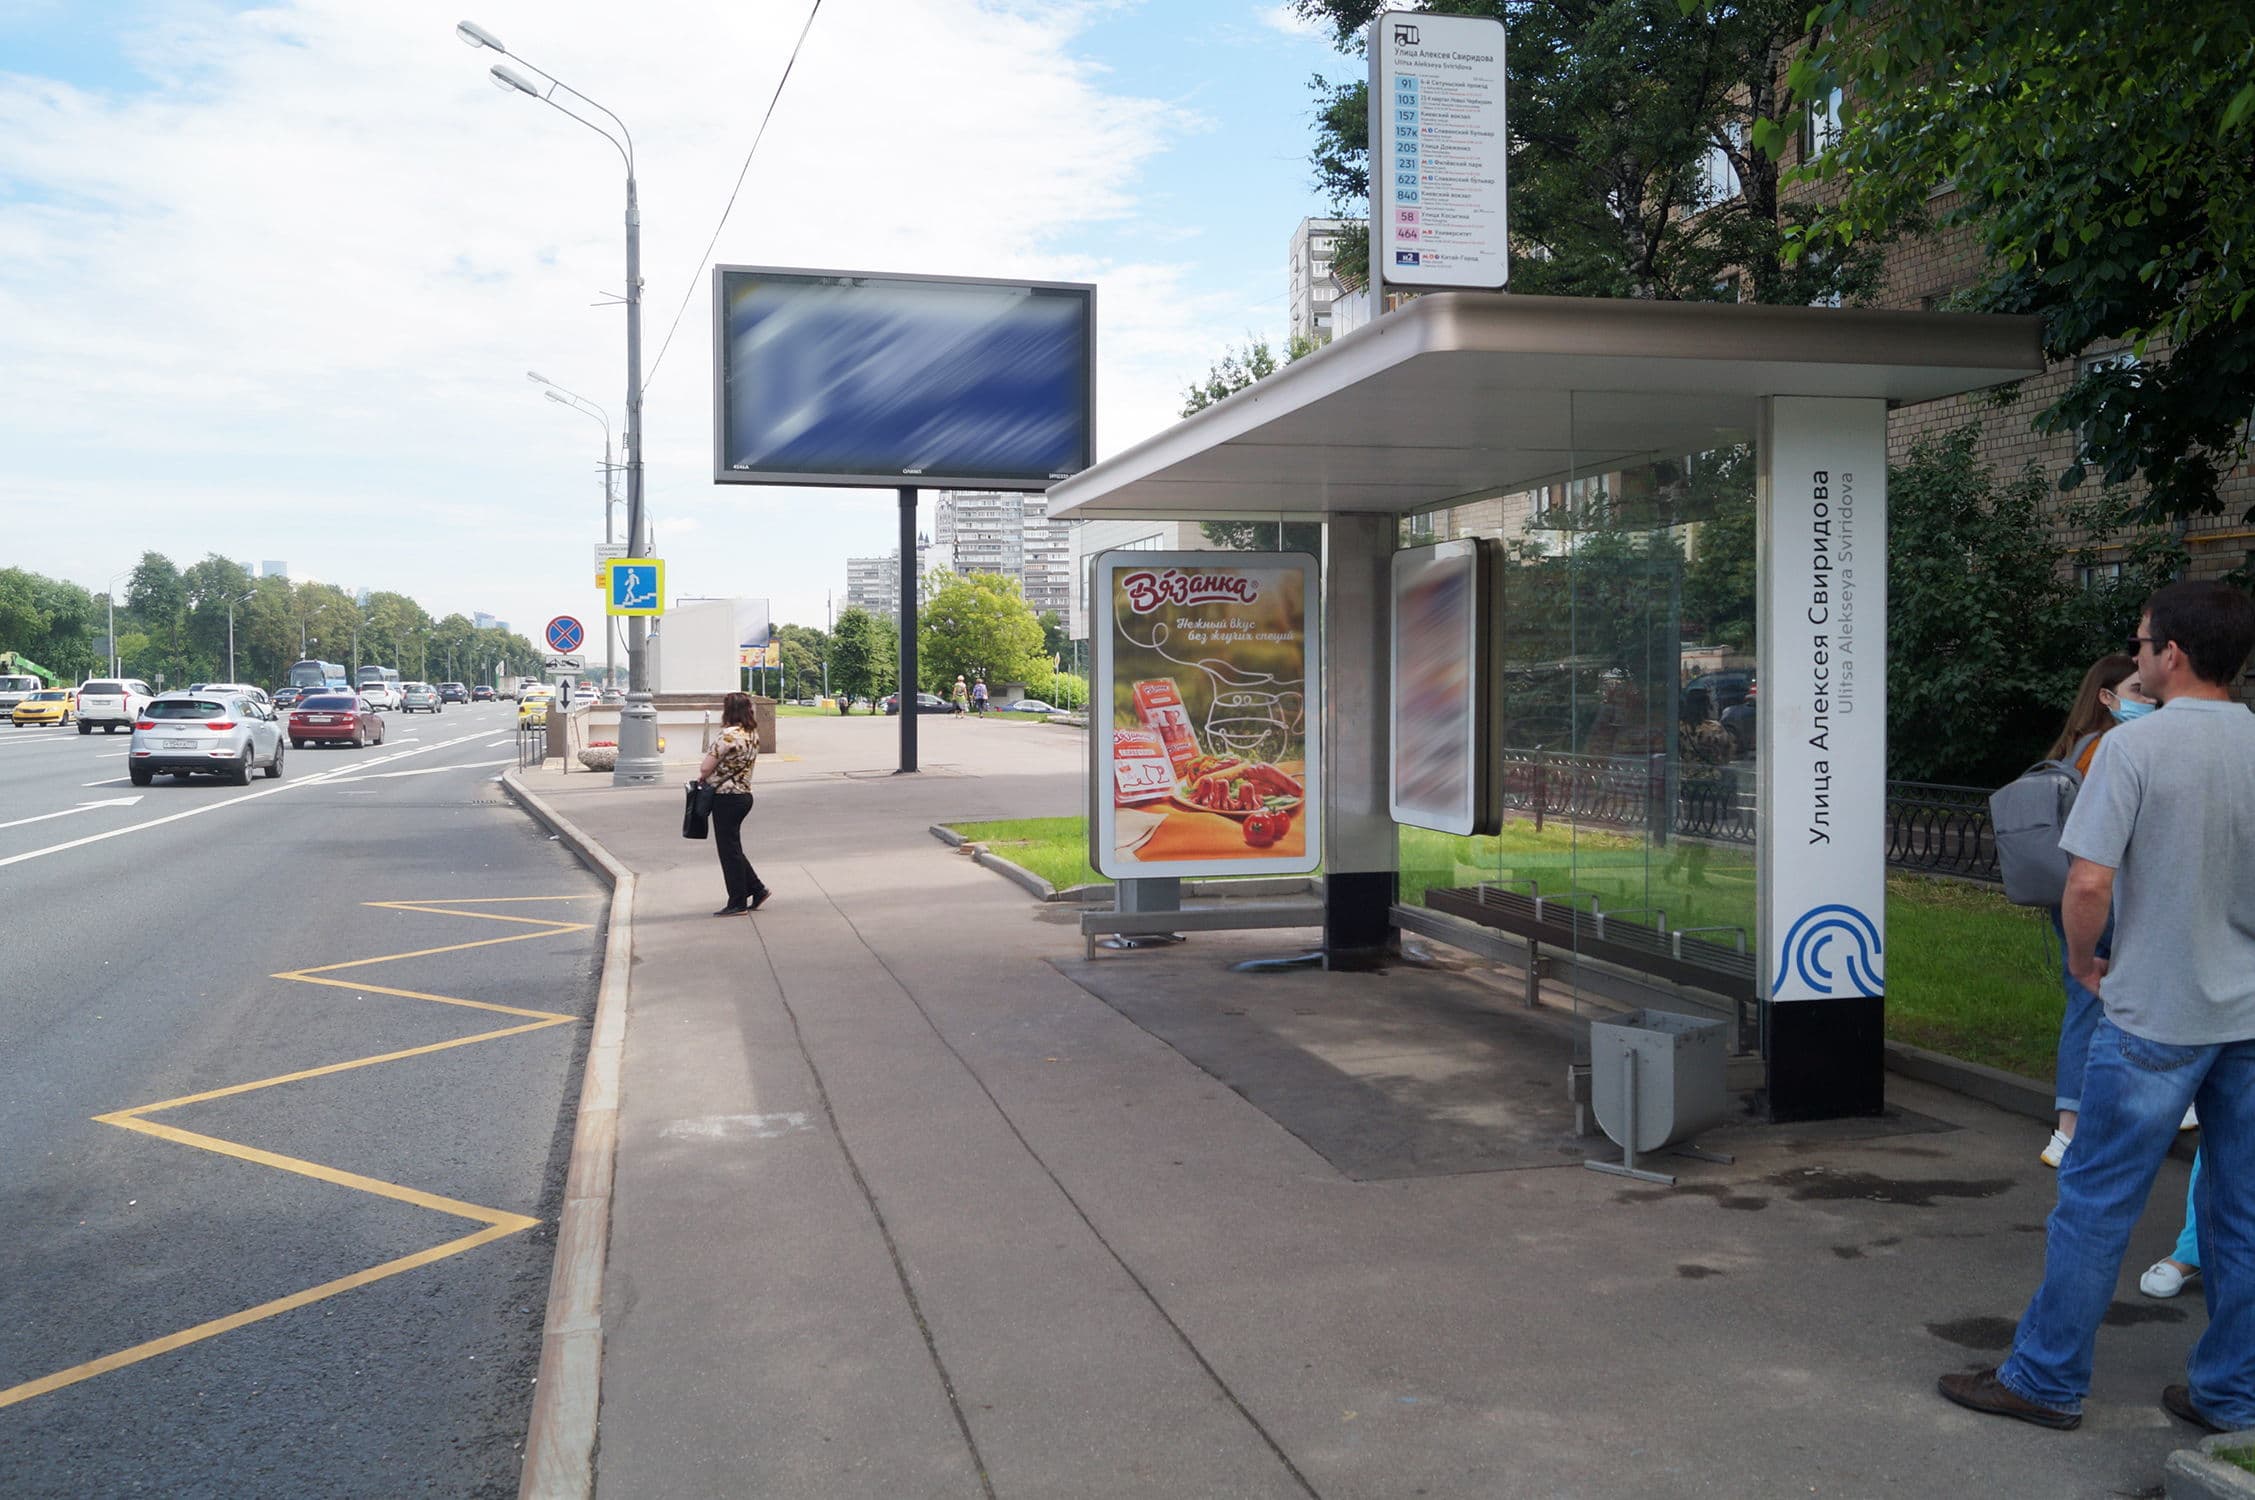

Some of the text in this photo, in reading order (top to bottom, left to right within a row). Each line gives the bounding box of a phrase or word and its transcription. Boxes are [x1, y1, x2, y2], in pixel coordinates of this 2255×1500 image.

[1394, 48, 1494, 62] Улица Алексея Свиридова
[1394, 58, 1472, 70] Ulitsa Alekseya Sviridova
[1401, 79, 1412, 88] 91
[1398, 94, 1416, 104] 103
[1400, 110, 1415, 120] 157
[1398, 142, 1417, 152] 205
[1400, 158, 1415, 168] 231
[1398, 176, 1416, 184] 622
[1397, 190, 1418, 200] 840
[1401, 212, 1414, 222] 58
[1398, 229, 1418, 238] 464
[1124, 569, 1257, 612] Вязанка
[1838, 472, 1856, 714] Ulitsa Alekseya Sviridova
[1176, 618, 1256, 632] Нежный вкус
[1188, 630, 1295, 644] без жгучих специй
[1808, 470, 1833, 845] Улица Алексея Свиридова
